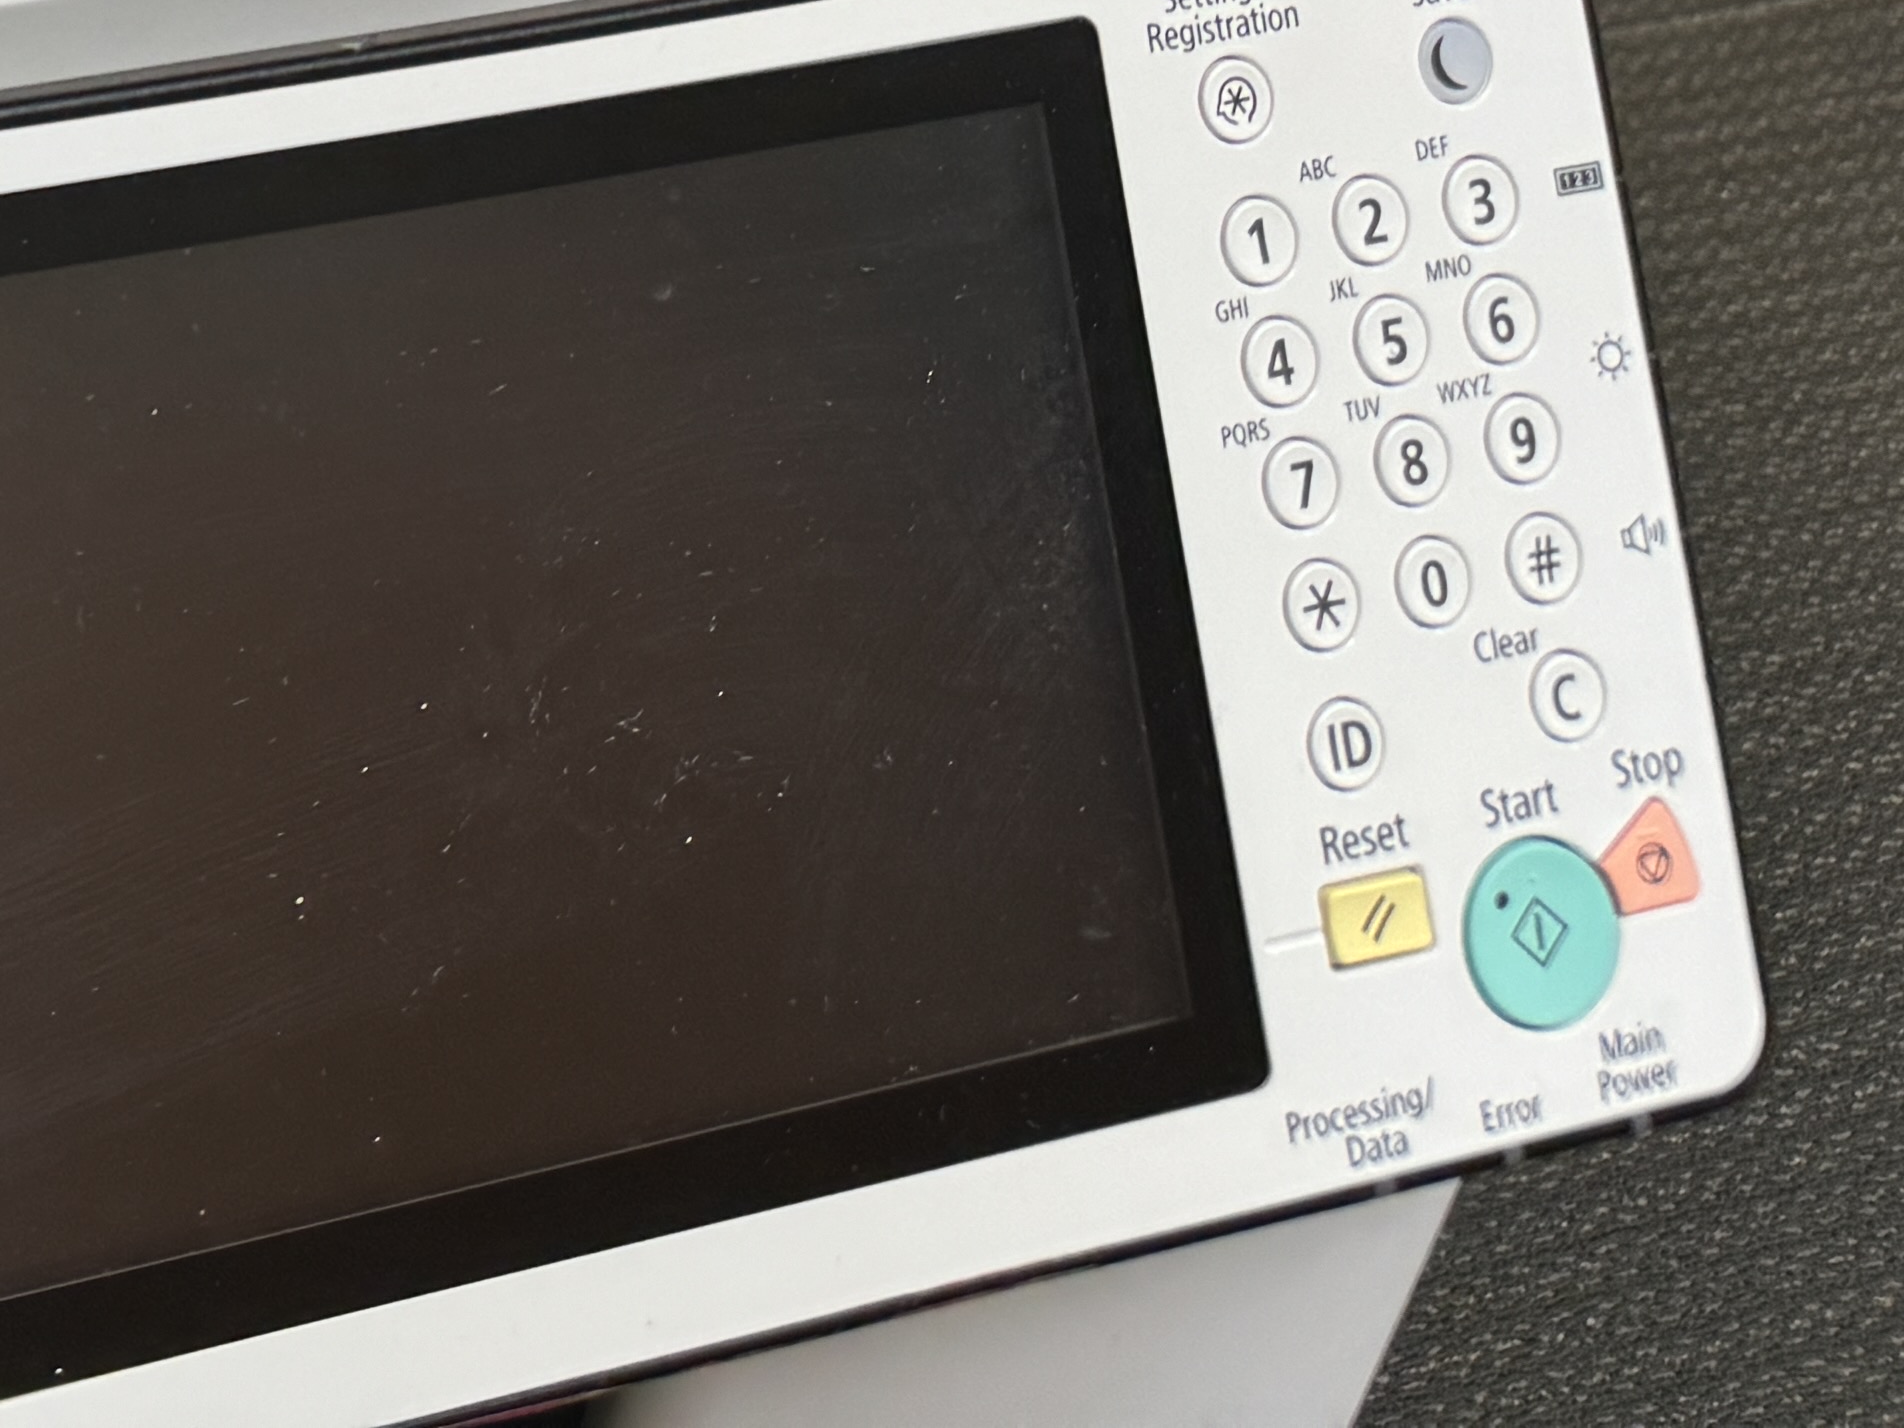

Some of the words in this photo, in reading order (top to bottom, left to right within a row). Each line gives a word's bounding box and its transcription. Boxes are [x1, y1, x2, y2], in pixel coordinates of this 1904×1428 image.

[1147, 1, 1300, 54] Registration
[1299, 156, 1336, 182] ABC
[1415, 135, 1449, 161] DEF
[1358, 198, 1388, 246] 2
[1468, 178, 1495, 225] 3
[1248, 217, 1270, 265] 1
[1329, 277, 1359, 302] JKL
[1426, 256, 1471, 282] MNO
[1215, 297, 1249, 324] GHI
[1487, 296, 1515, 344] 6
[1267, 339, 1294, 386] 4
[1381, 317, 1408, 364] 5
[1344, 397, 1380, 423] TUV
[1436, 375, 1492, 404] WXYZ
[1220, 420, 1271, 448] PQRS
[1509, 417, 1536, 463] 9
[1290, 460, 1315, 508] 7
[1400, 438, 1428, 485] 8
[1420, 560, 1447, 608] 0
[1528, 537, 1561, 585] #
[1473, 629, 1539, 664] Clear
[1552, 673, 1580, 721] C
[1327, 720, 1372, 771] ID
[1610, 744, 1684, 787] Stop
[1480, 780, 1558, 828] Start
[1319, 814, 1409, 865] Reset
[1599, 1023, 1665, 1063] Main
[1598, 1059, 1678, 1101] Power
[1286, 1076, 1434, 1144] Processing/
[1480, 1093, 1543, 1133] Error
[1346, 1127, 1409, 1168] Data
